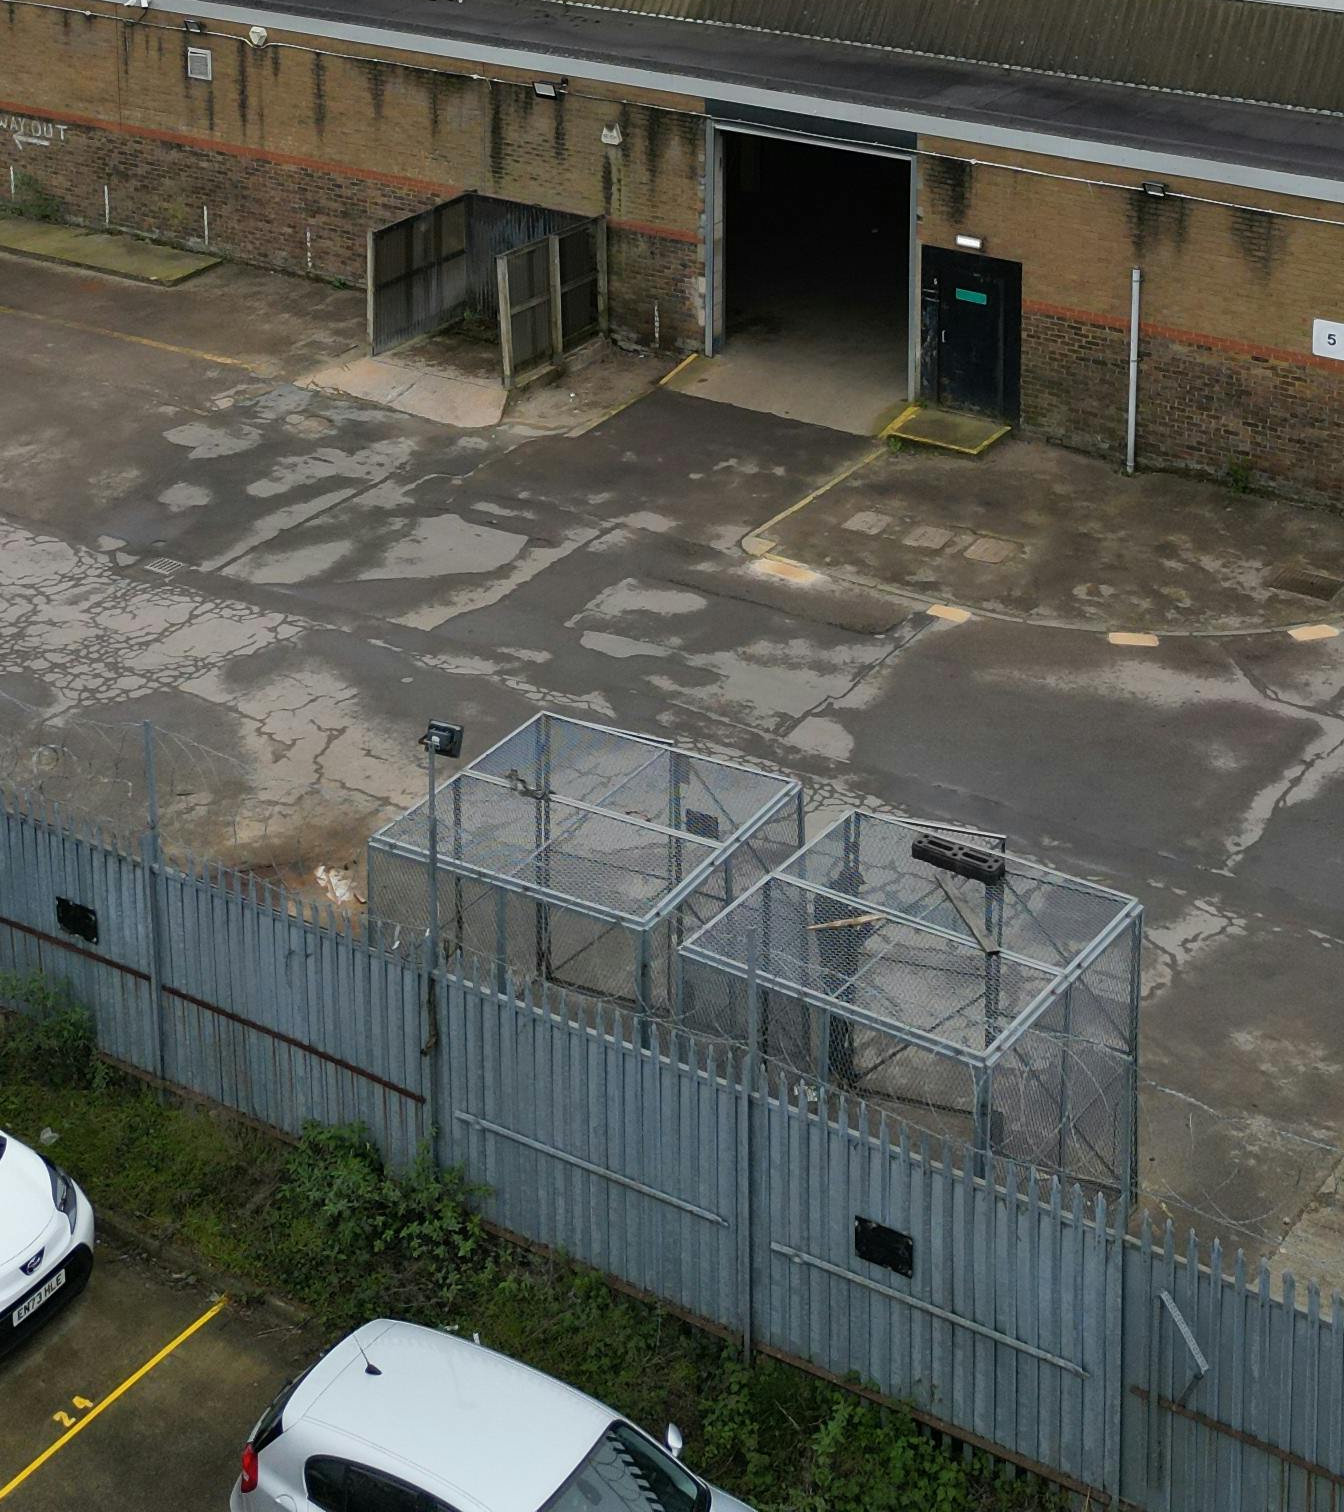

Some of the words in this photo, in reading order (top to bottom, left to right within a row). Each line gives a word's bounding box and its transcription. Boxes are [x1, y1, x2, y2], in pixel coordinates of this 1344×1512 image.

[31, 120, 68, 141] OUT
[1327, 333, 1337, 346] 5
[17, 1293, 43, 1321] EN73
[44, 1272, 62, 1298] HLE
